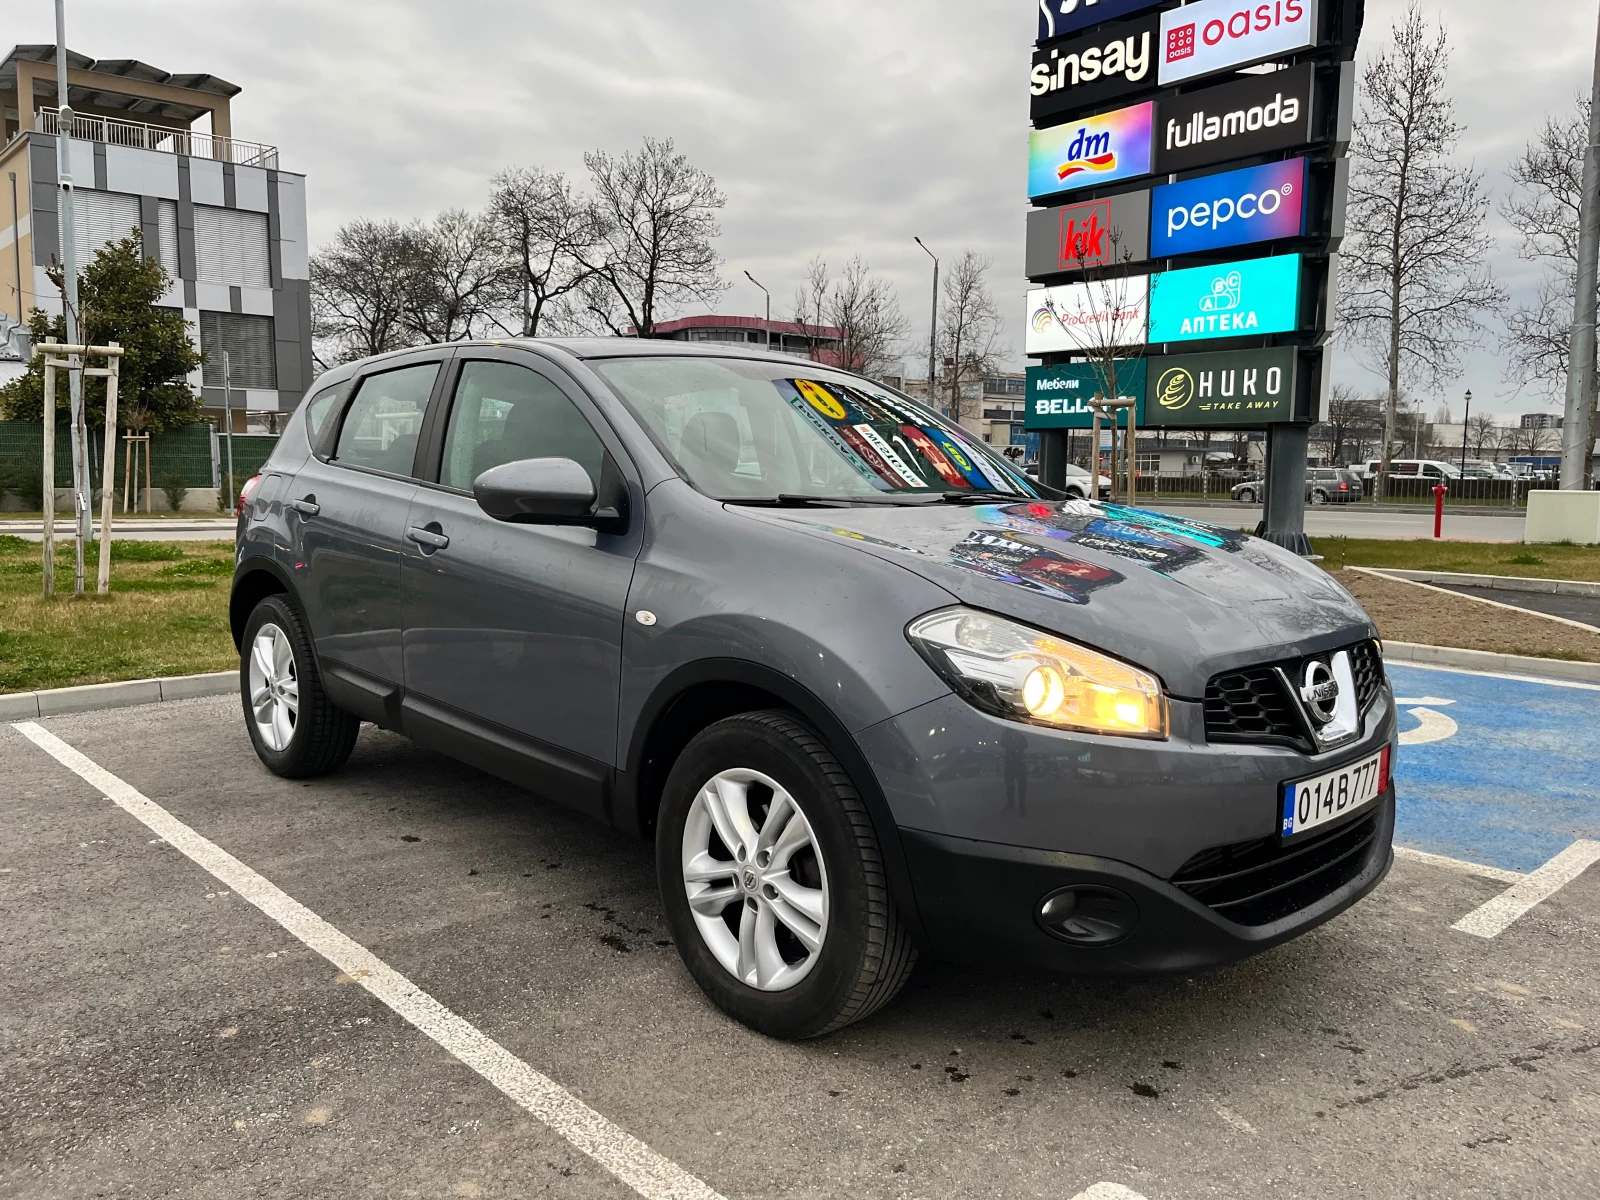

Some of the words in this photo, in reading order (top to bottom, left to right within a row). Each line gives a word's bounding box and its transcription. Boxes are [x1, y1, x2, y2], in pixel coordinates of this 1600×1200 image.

[1202, 0, 1303, 46] oasis
[1030, 31, 1150, 96] sinsay
[1168, 46, 1191, 58] oasis
[1166, 93, 1299, 150] fullamoda
[1067, 128, 1110, 162] dm
[1167, 189, 1281, 238] pepco
[1061, 311, 1109, 325] ProCredit
[1112, 307, 1140, 321] Bank
[1180, 311, 1258, 335] АПТЕКА
[1036, 379, 1079, 391] Мебели
[1213, 402, 1242, 410] TAKE
[1246, 400, 1279, 409] AWAY
[1298, 758, 1378, 825] 014B777
[1283, 817, 1293, 831] BG
